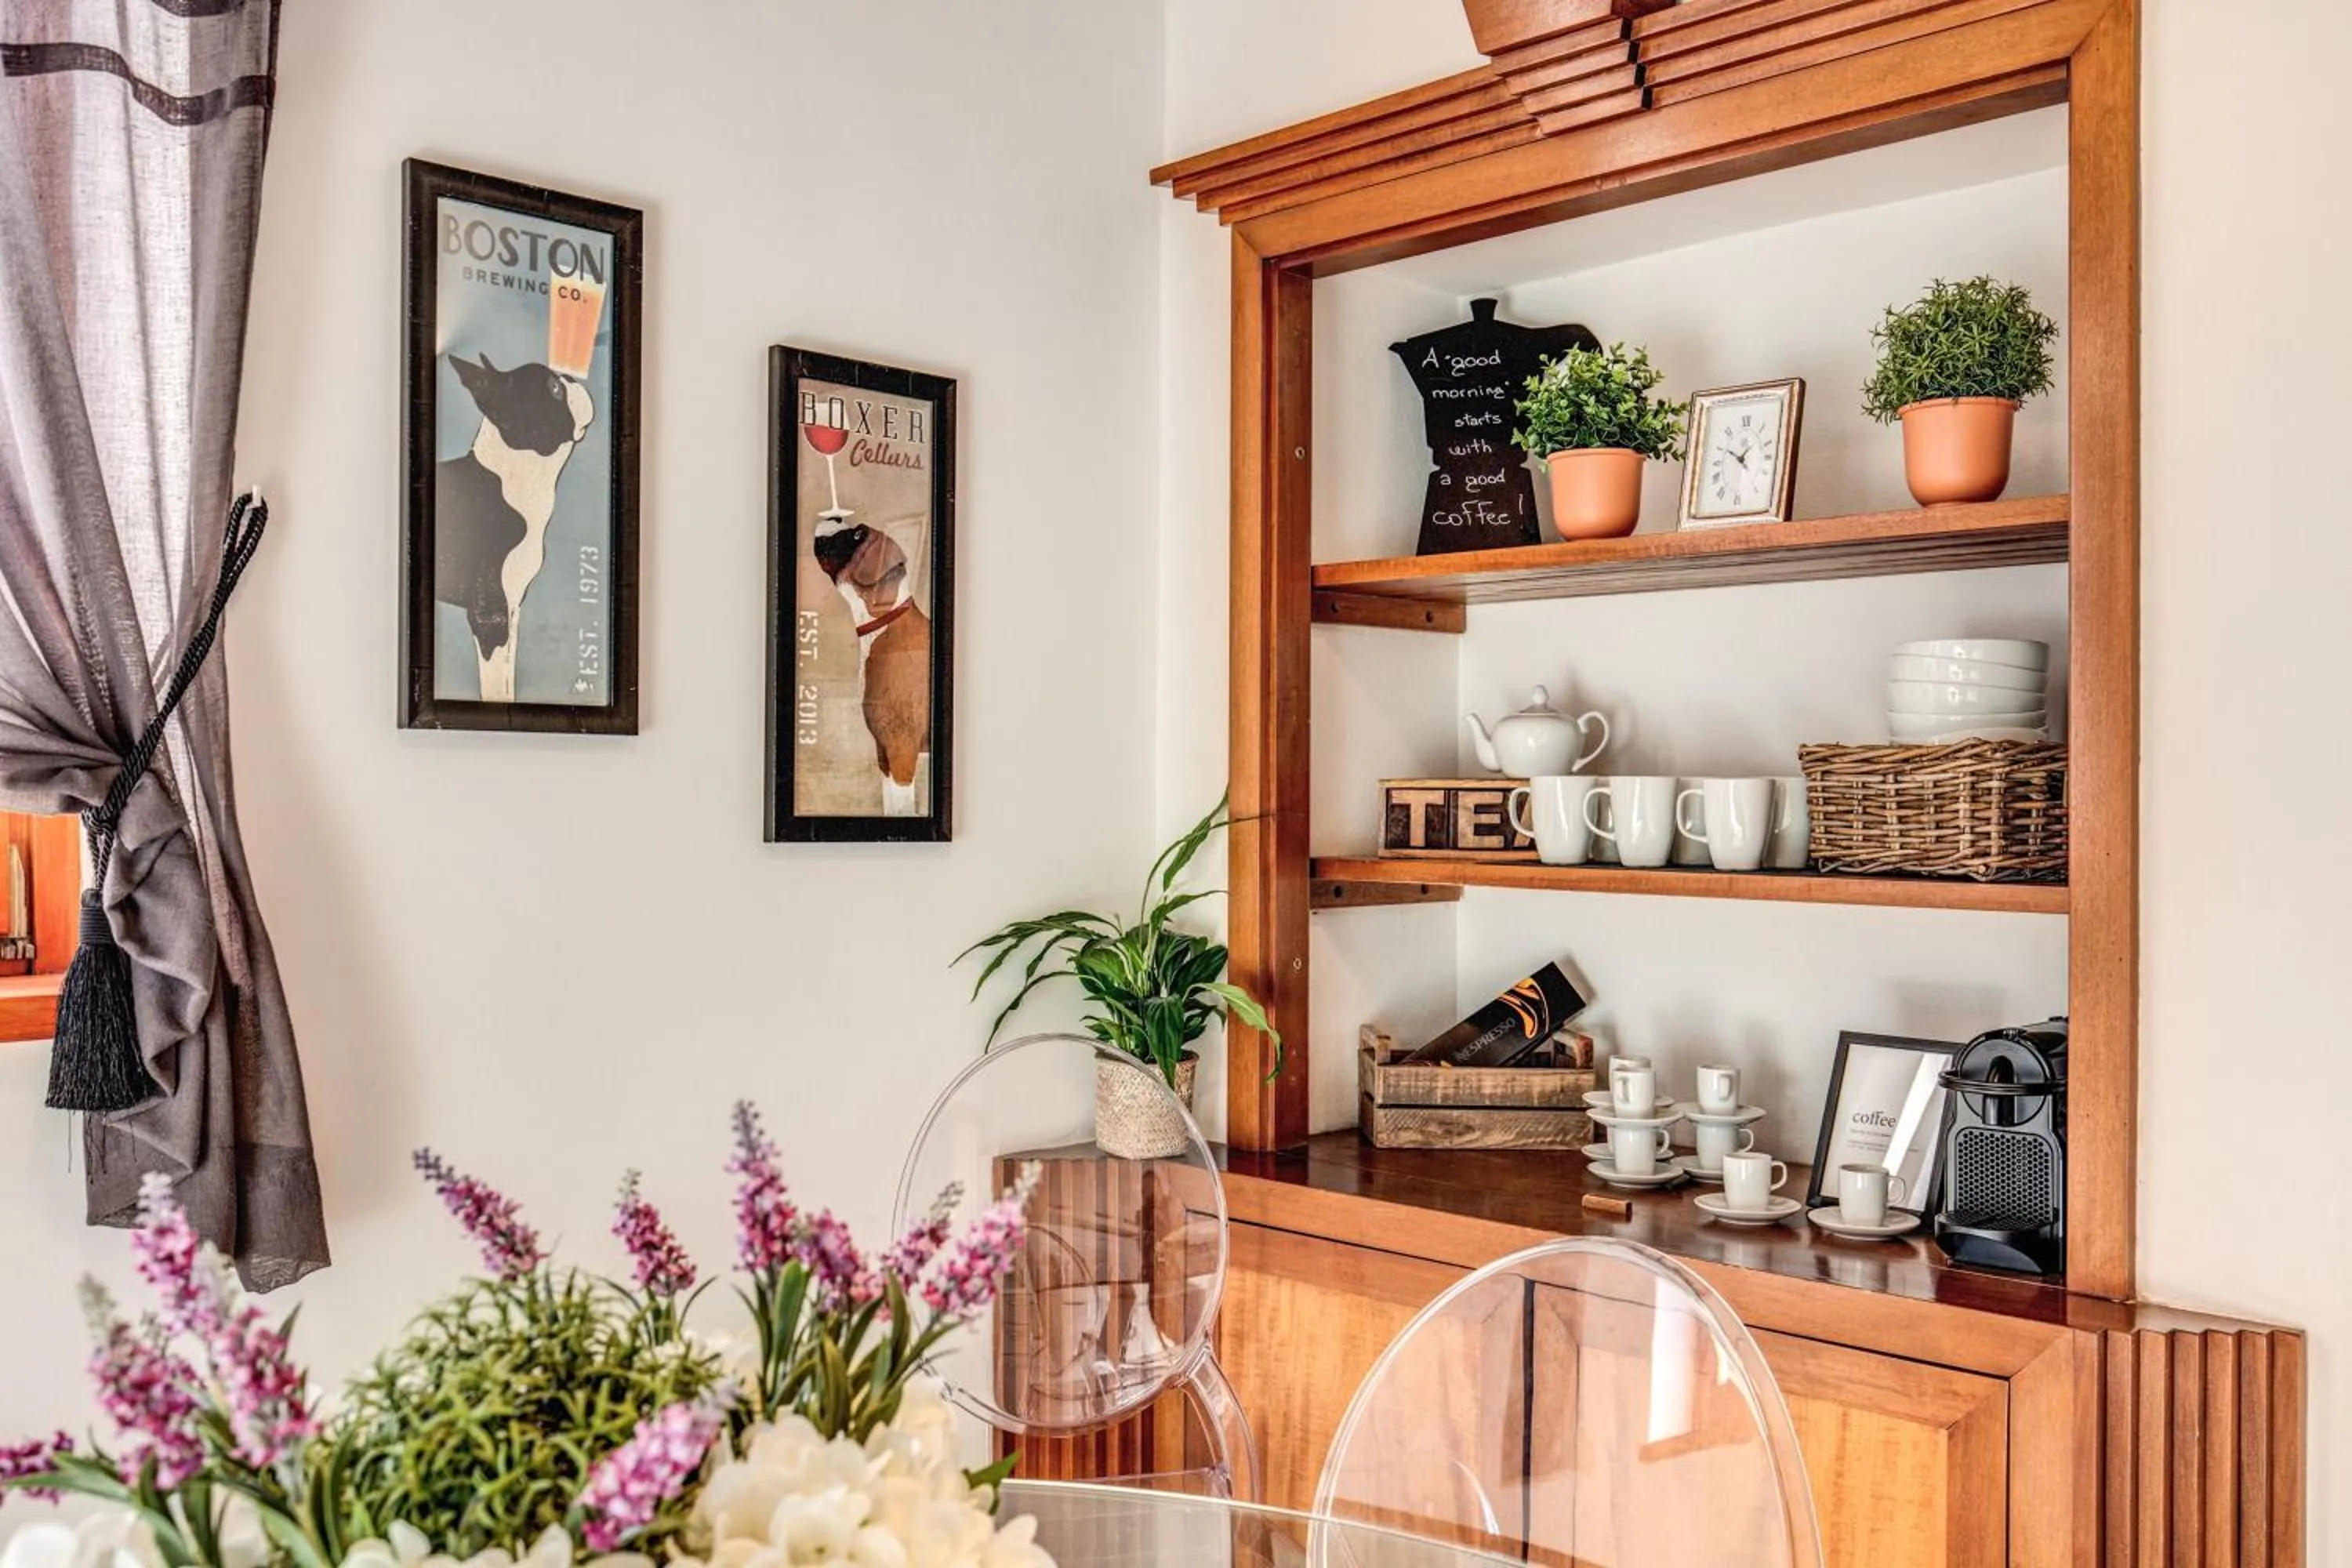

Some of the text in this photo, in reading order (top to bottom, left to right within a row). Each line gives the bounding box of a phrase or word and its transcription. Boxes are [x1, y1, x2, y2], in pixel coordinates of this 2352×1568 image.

[441, 213, 604, 285] BOSTON
[463, 266, 549, 296] BREWING
[1421, 347, 1501, 377] A good
[1432, 385, 1506, 399] morning
[800, 391, 926, 444] BOXER
[1454, 411, 1502, 427] starts
[849, 438, 924, 470] Cellars
[1448, 437, 1493, 456] with
[1439, 467, 1505, 493] a good
[578, 545, 599, 675] EST. 1973
[798, 610, 818, 746] EST. 2013
